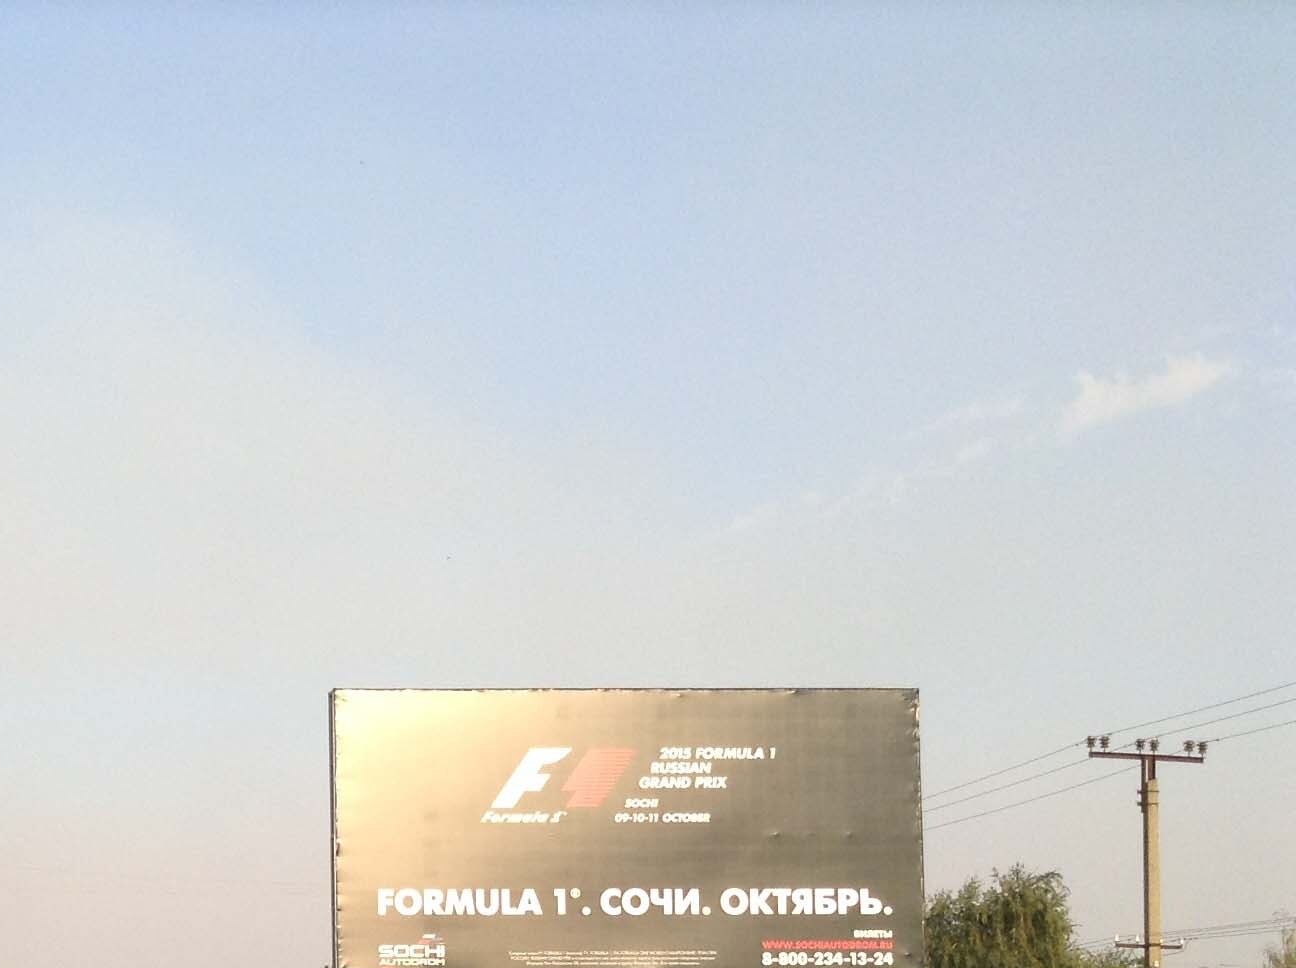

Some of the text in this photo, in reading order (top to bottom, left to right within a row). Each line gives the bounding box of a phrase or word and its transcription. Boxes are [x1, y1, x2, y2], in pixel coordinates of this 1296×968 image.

[659, 747, 777, 760] 2015 FORMULA 1
[650, 762, 712, 774] RUSSIAN
[638, 777, 728, 789] GRAND PRIX
[624, 798, 660, 808] SOCHI
[480, 811, 548, 824] Formula
[614, 812, 711, 823] 09-10-11 OCTOBER
[378, 888, 542, 915] FORMULA
[600, 887, 712, 916] СОЧИ.
[720, 887, 893, 916] ОКТЯБРЬ.
[378, 944, 445, 958] SOCHI
[378, 958, 446, 966] AUTODROM
[761, 951, 894, 966] 8-800-234-13-24
